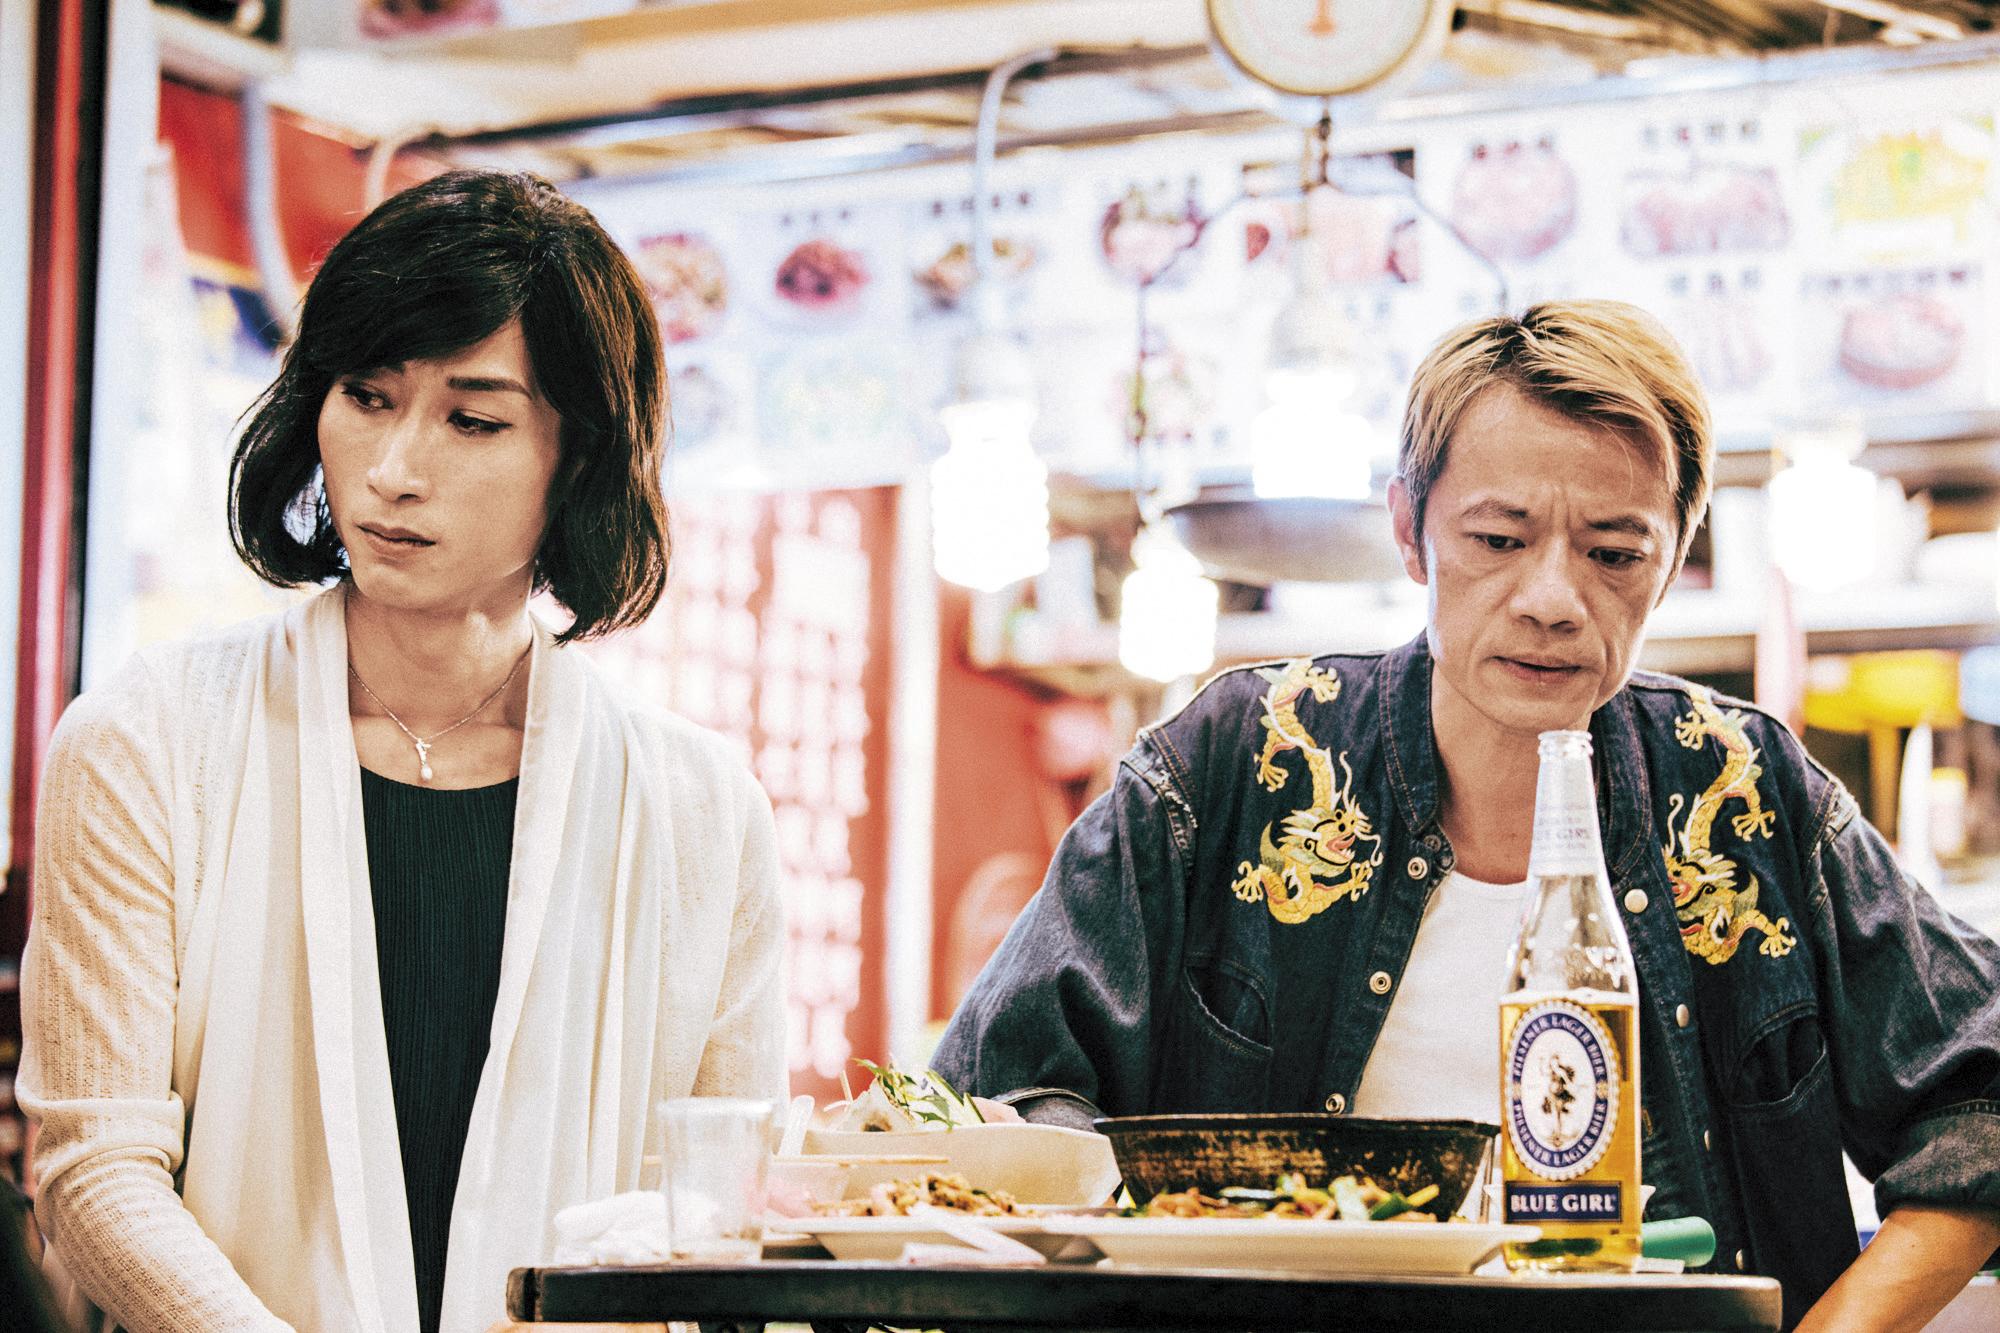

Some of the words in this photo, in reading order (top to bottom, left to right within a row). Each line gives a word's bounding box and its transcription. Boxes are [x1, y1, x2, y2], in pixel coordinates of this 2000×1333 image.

[1552, 1014, 1592, 1046] LAGER
[1553, 1136, 1595, 1166] LAGER
[1589, 1103, 1607, 1136] BIER
[1511, 1194, 1559, 1212] BLUE
[1562, 1194, 1616, 1212] GIRL
